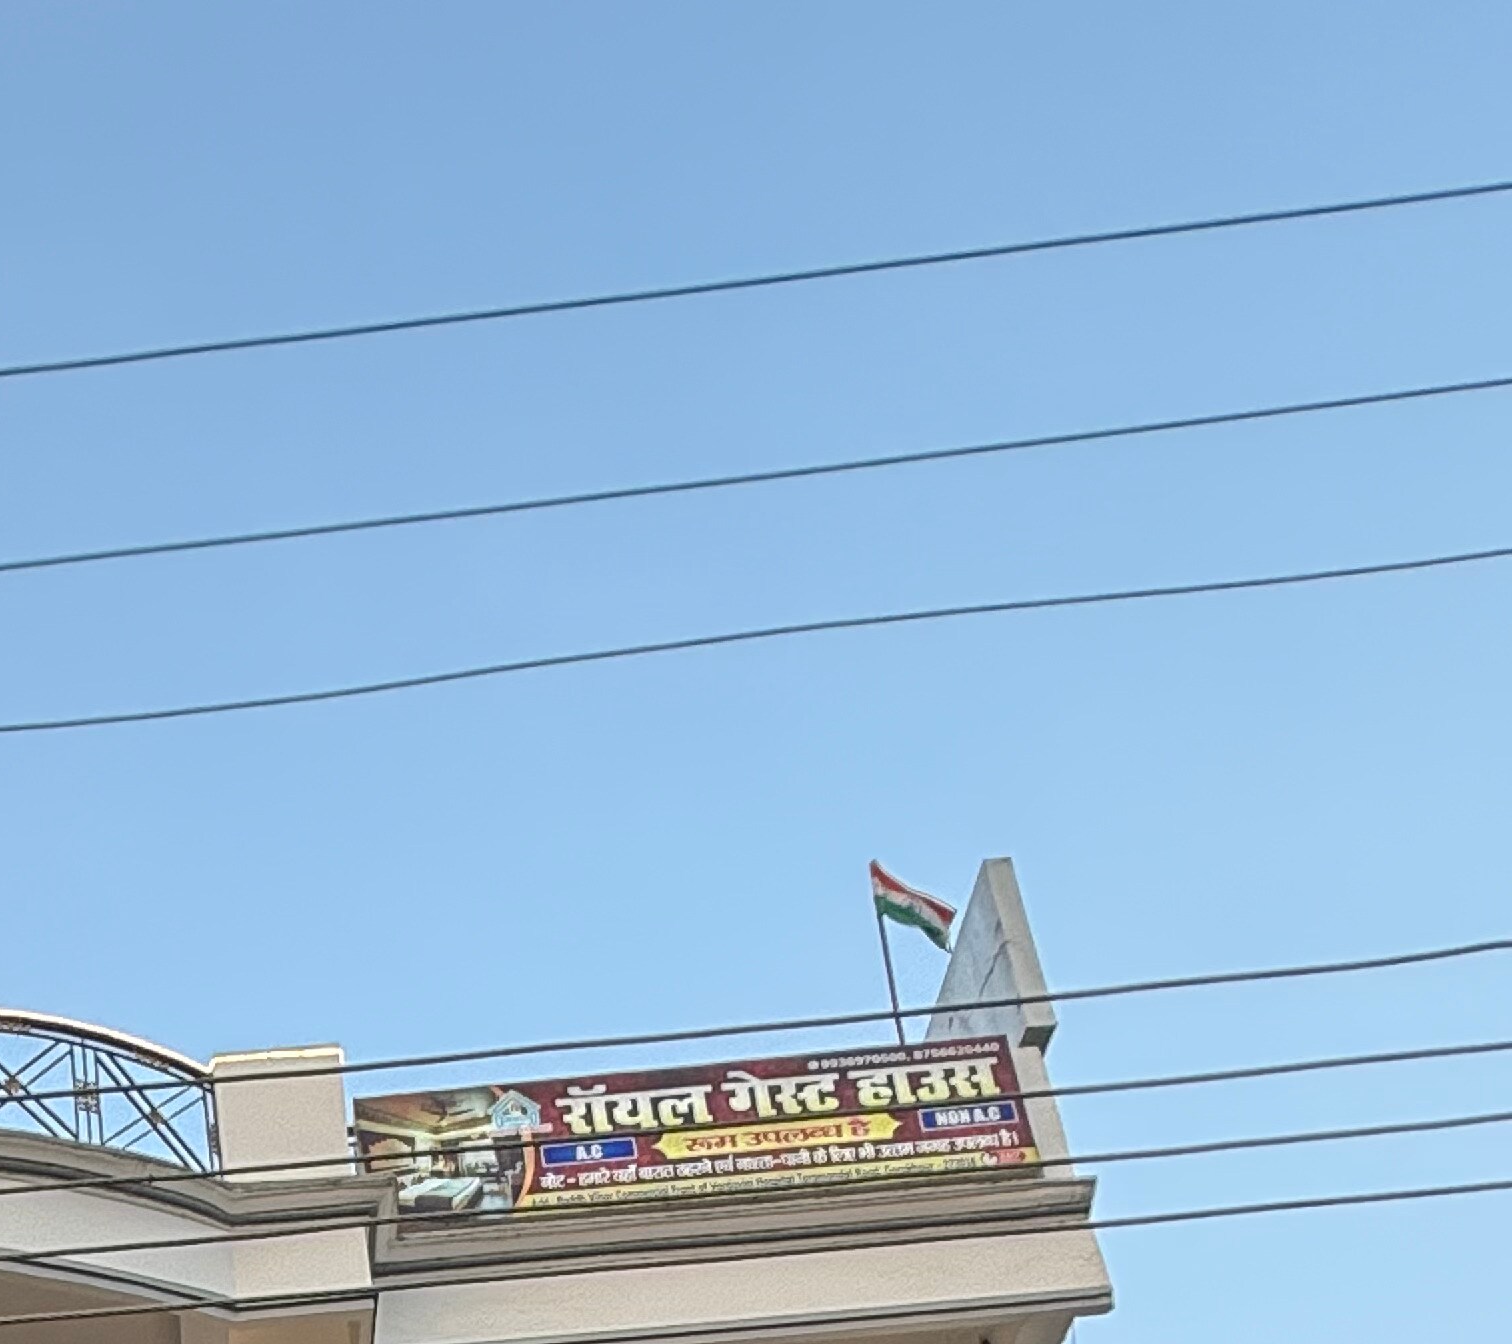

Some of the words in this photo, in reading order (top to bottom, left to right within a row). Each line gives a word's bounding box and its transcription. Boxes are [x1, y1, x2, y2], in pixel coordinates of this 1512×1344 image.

[555, 1084, 714, 1134] रॉयल
[721, 1070, 839, 1118] गेस्ट
[847, 1057, 1001, 1106] हाउस
[935, 1108, 971, 1126] NON
[685, 1130, 738, 1151] रूम
[745, 1121, 843, 1147] उपलब्ध
[848, 1118, 871, 1136] है
[576, 1144, 603, 1160] A.C
